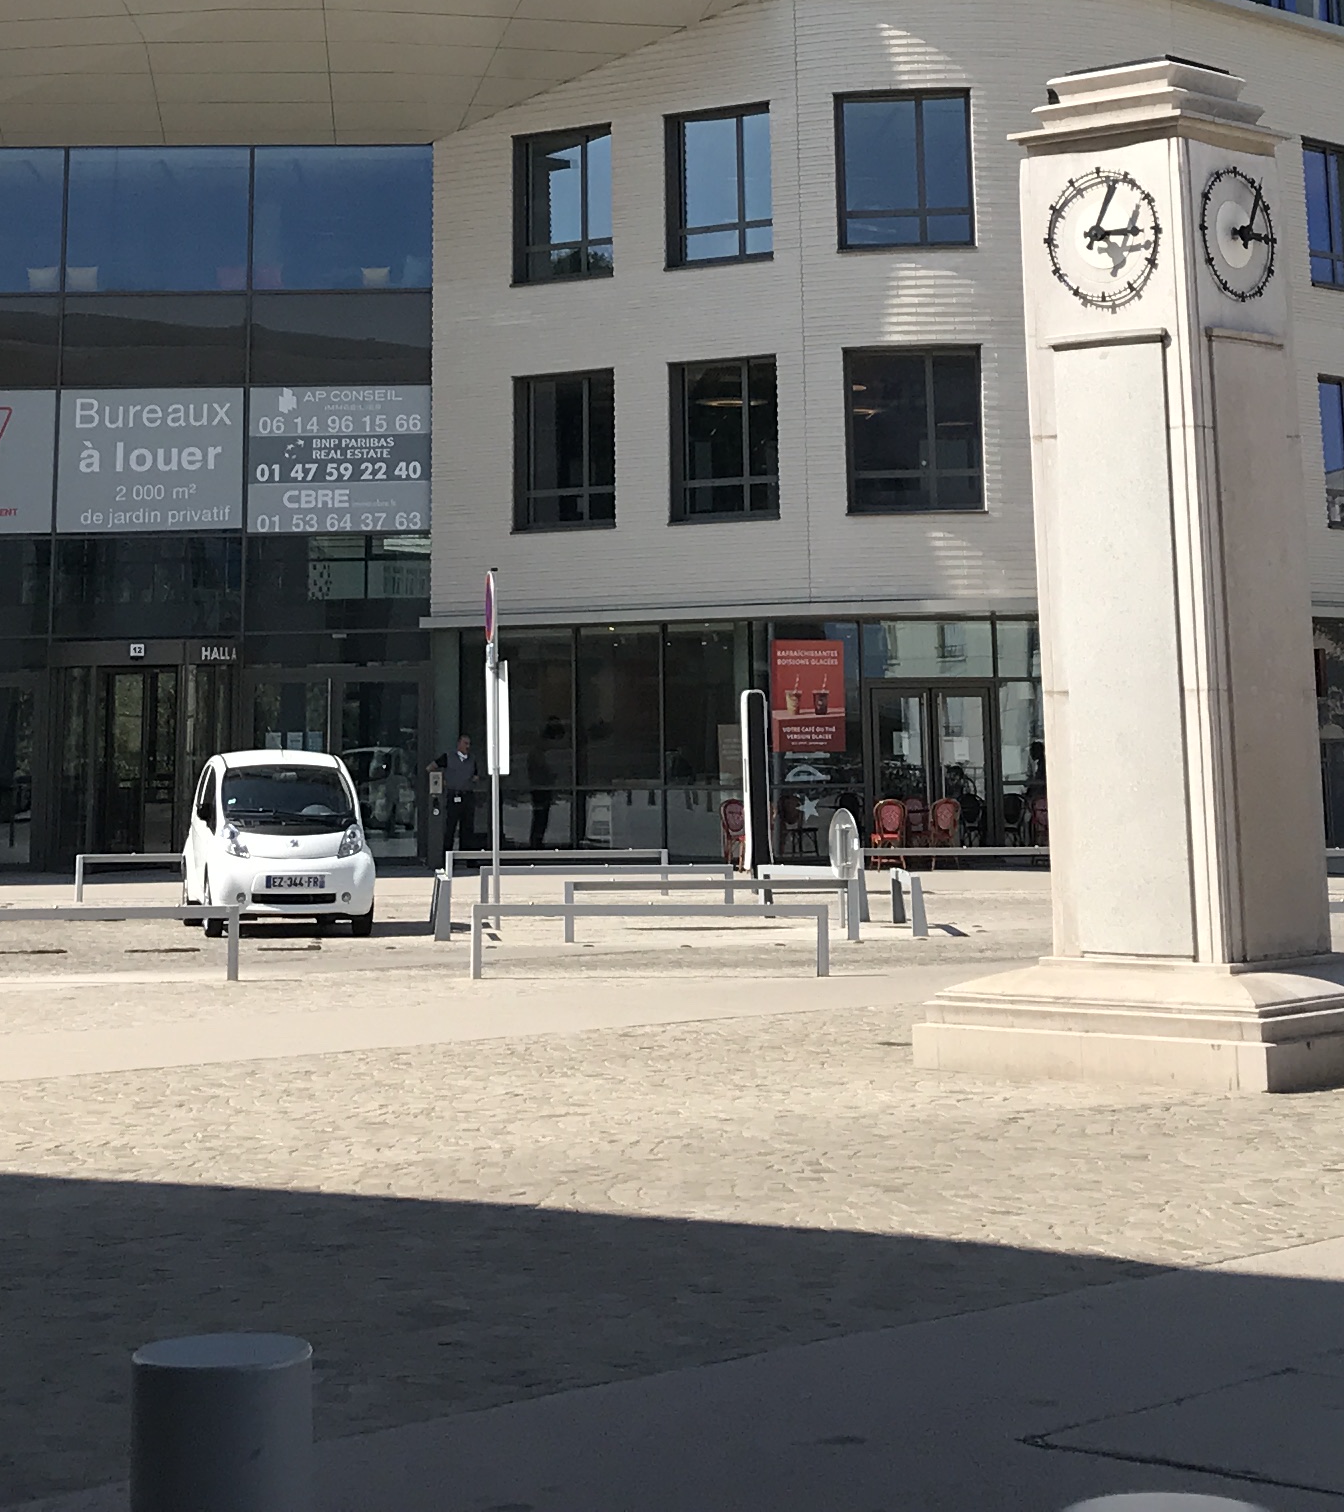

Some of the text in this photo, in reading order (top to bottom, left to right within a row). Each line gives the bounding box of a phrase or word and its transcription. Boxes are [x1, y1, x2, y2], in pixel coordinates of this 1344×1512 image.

[303, 389, 403, 402] AP CONSEIL
[75, 398, 232, 429] Bureaux
[258, 414, 422, 434] 06 14 96 15 66
[312, 437, 395, 449] BNP PARIBAS
[78, 440, 223, 473] à louer
[312, 448, 391, 460] REAL ESTATE
[256, 461, 422, 482] 01 47 59 22 40
[115, 485, 127, 501] 2
[132, 484, 165, 500] 000
[282, 489, 350, 508] CBRE
[80, 505, 231, 528] de jardin privatif
[256, 511, 422, 532] 01 53 64 37 63
[201, 646, 231, 660] HALL
